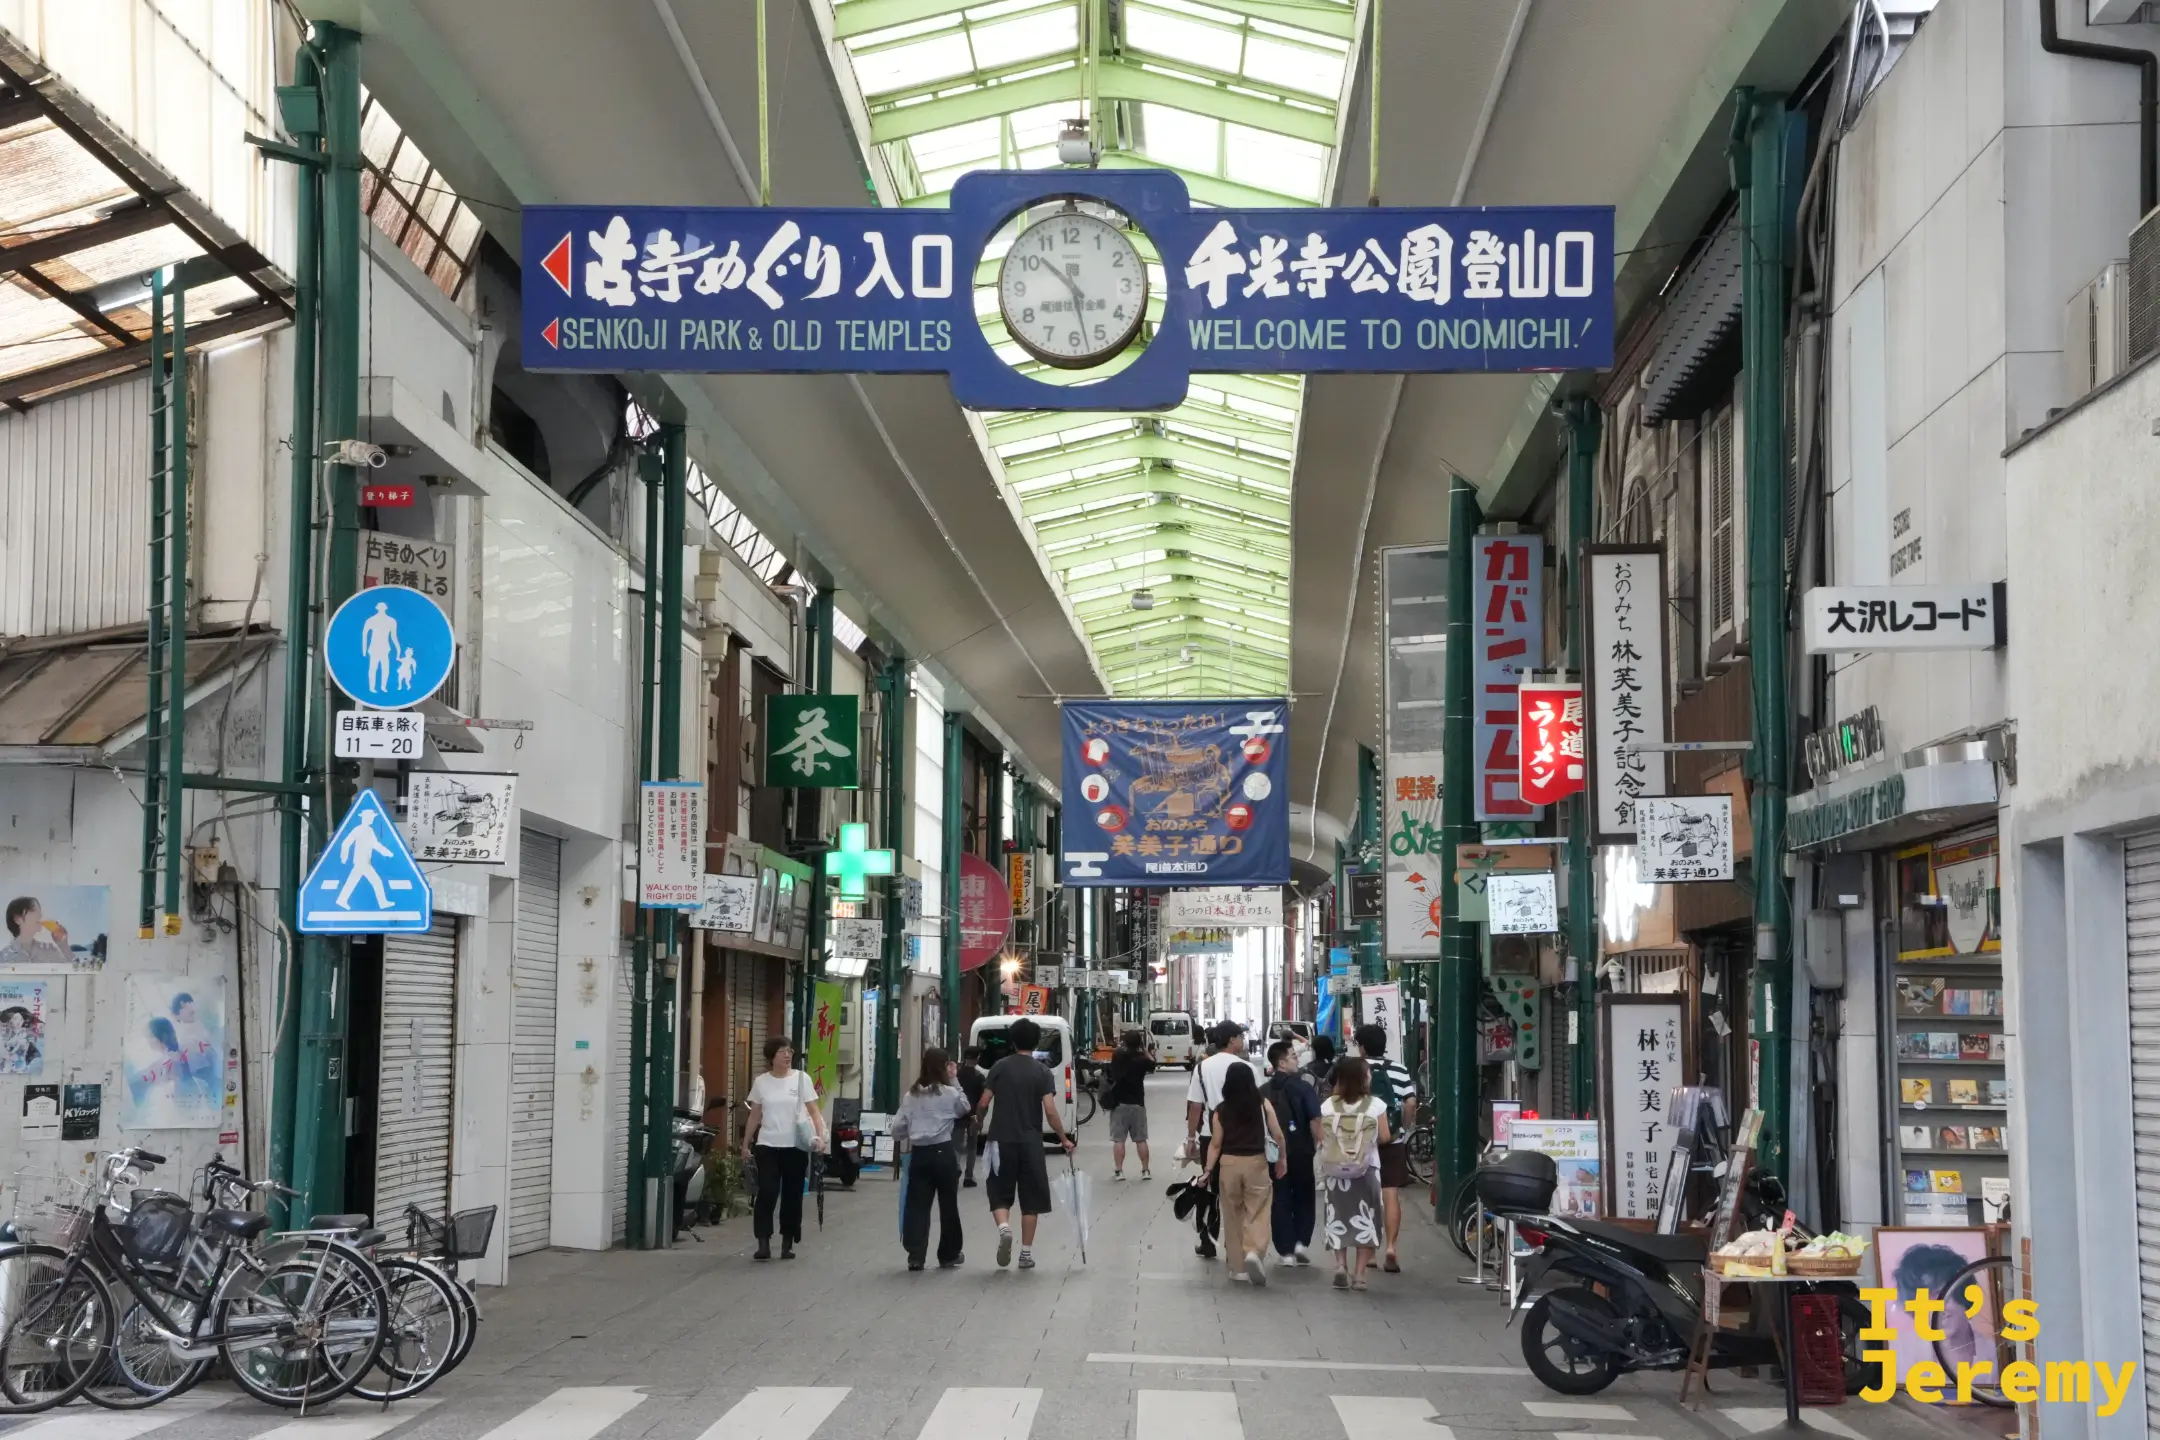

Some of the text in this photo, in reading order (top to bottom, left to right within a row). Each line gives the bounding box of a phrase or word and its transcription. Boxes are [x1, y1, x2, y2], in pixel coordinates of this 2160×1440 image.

[1038, 235, 1054, 251] 11
[1061, 228, 1080, 244] 12
[1094, 234, 1101, 250] 1
[585, 215, 953, 310] 古寺めぐり入口
[1020, 255, 1040, 271] 10
[1112, 252, 1123, 268] 2
[1184, 218, 1594, 309] 千光寺公園登山口
[1014, 281, 1026, 297] 9
[1120, 278, 1131, 294] 3
[1022, 307, 1035, 323] 8
[1112, 304, 1124, 321] 4
[562, 318, 952, 352] SENKOJI PARK & OLD TEMPLES
[1043, 326, 1055, 342] 7
[1068, 331, 1080, 347] 6
[1094, 324, 1106, 341] 5
[1188, 318, 1593, 350] WELCOME TO ONOMICHI!
[366, 537, 447, 570] 古寺めぐり
[1483, 540, 1530, 662] カバン
[1828, 597, 1987, 634] 大沢レコード
[342, 716, 419, 732] 自転車を除く
[770, 706, 852, 777] 茶
[1528, 700, 1556, 790] ラーメン
[1145, 818, 1209, 831] おのみち
[1111, 834, 1244, 857] 芙美子通り
[645, 883, 670, 891] WALK
[685, 883, 698, 891] the
[646, 892, 698, 900] RIGHT SIDE
[1196, 894, 1253, 904] ようこそ尾道市
[1178, 905, 1272, 918] 3つの日本遺産のまち
[1637, 1028, 1663, 1144] 林芙美子
